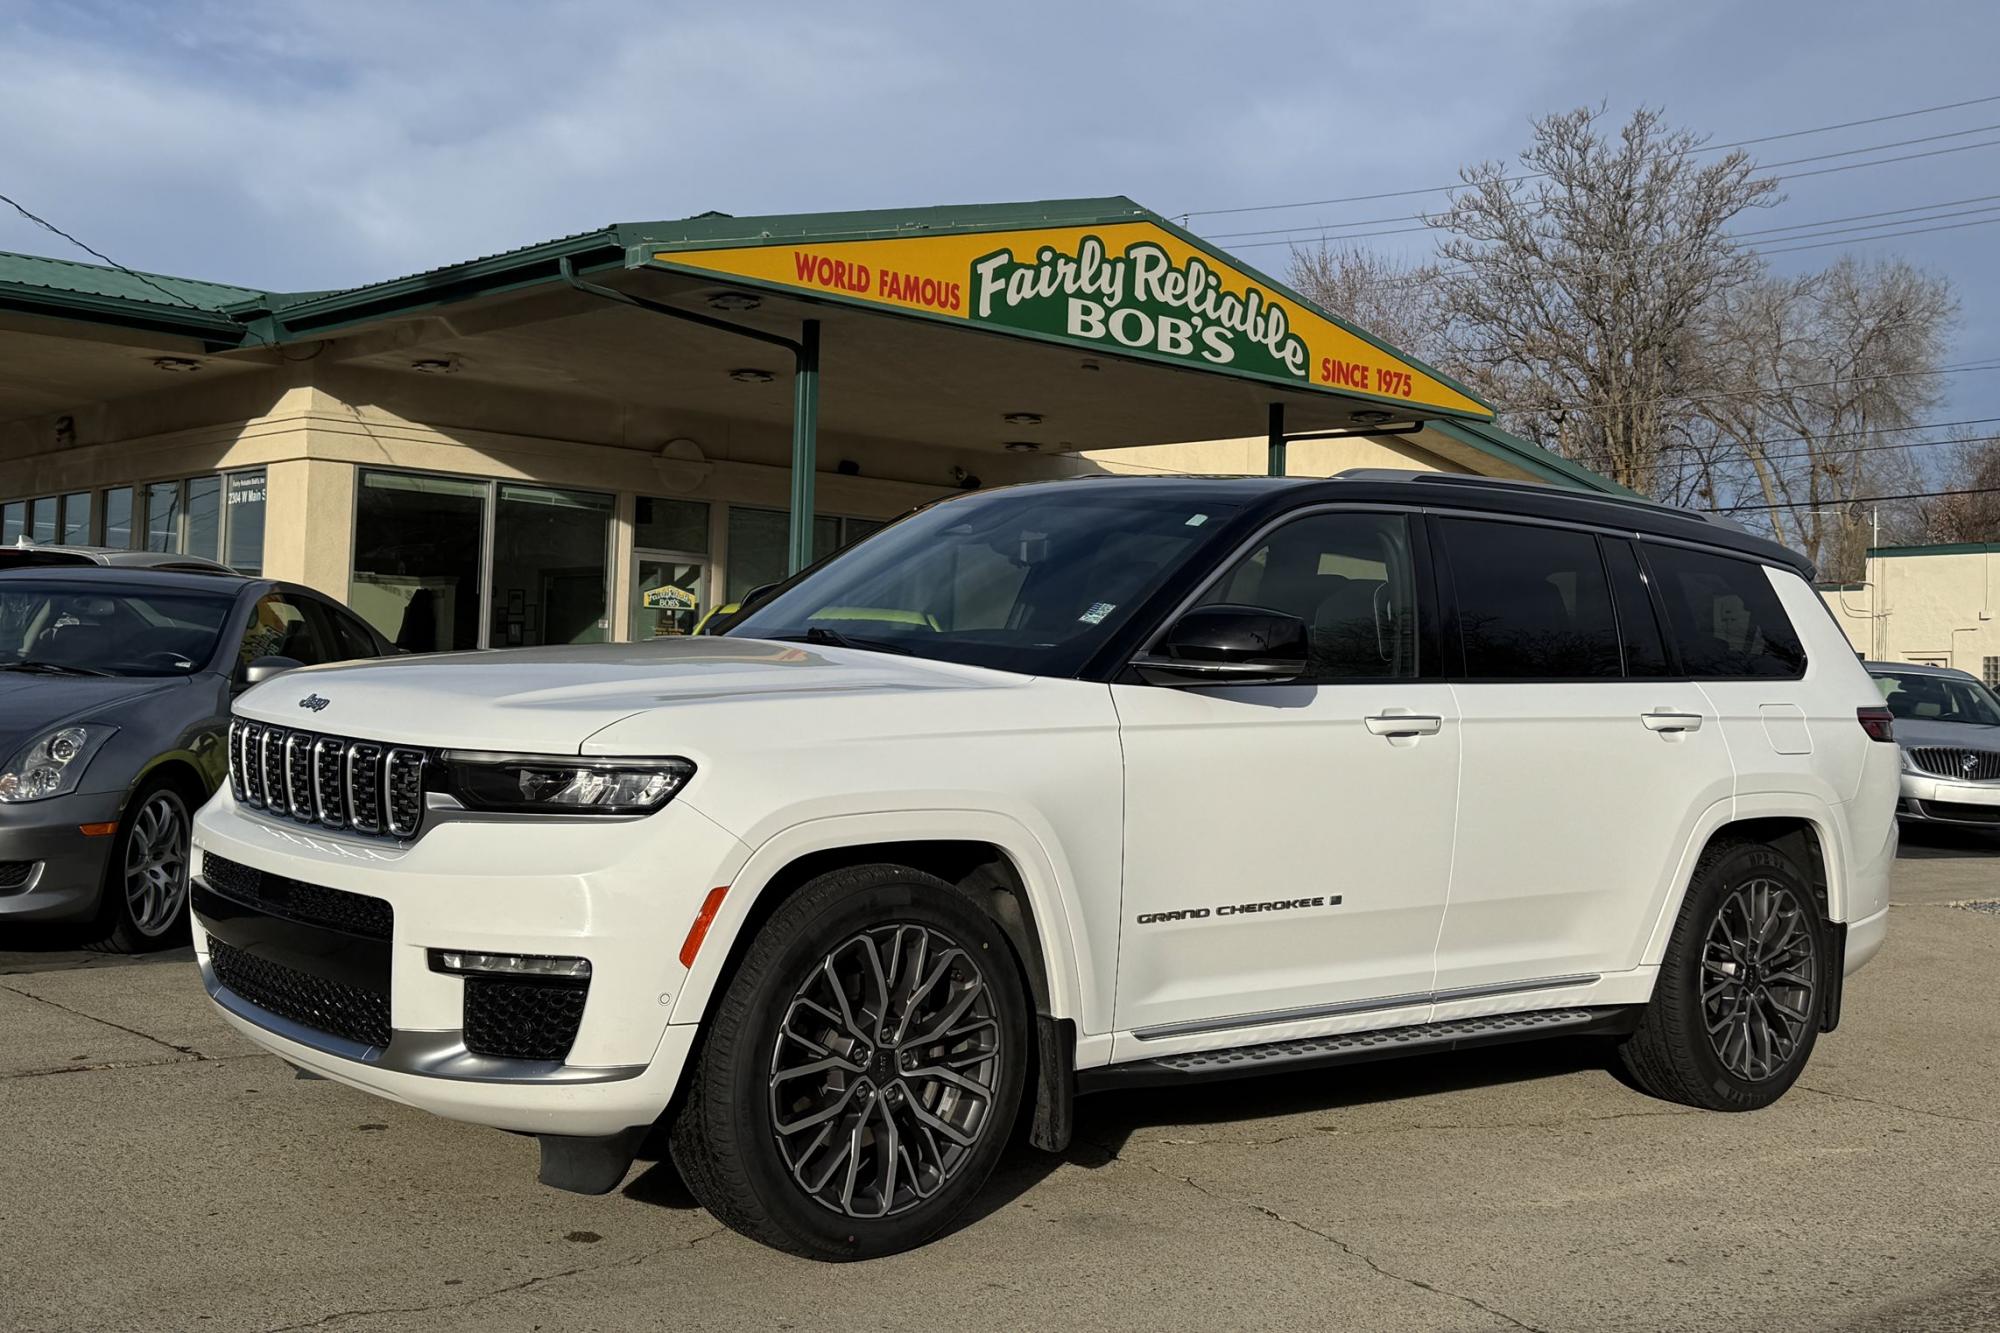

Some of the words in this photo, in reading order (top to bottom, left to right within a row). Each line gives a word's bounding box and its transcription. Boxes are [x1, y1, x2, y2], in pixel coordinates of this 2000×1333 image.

[794, 251, 871, 293] WORLD
[879, 269, 961, 311] FAMOUS
[976, 239, 1125, 318] Fairly
[1129, 245, 1306, 376] Reliable
[1067, 297, 1235, 364] BOB'S
[1321, 357, 1369, 390] SINCE
[1376, 368, 1412, 398] 1975
[241, 490, 248, 503] W
[248, 489, 261, 502] Main
[299, 693, 331, 713] Jeep
[1136, 907, 1211, 925] GRAND
[1215, 896, 1325, 917] CHEROKEE
